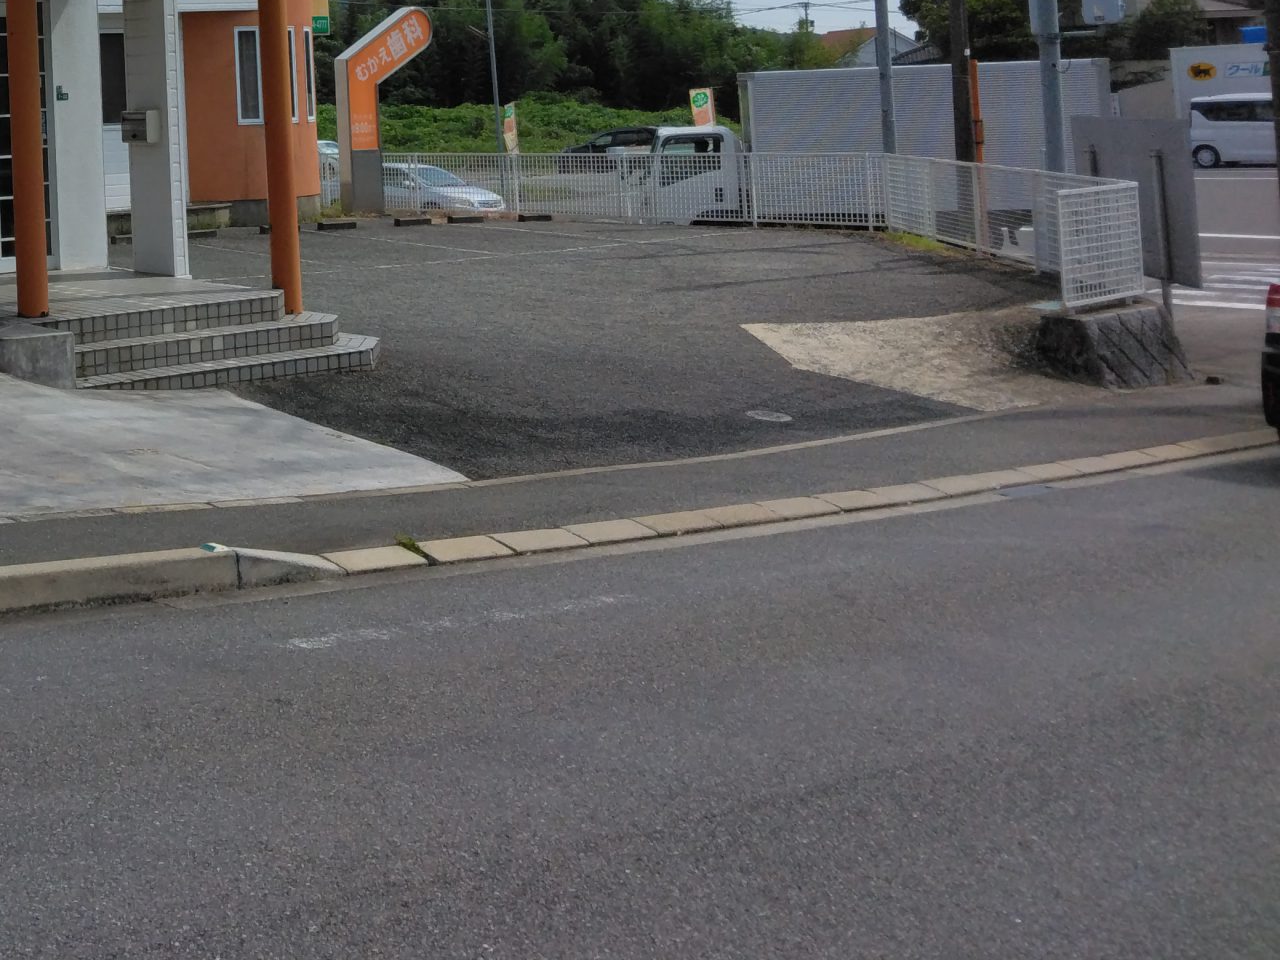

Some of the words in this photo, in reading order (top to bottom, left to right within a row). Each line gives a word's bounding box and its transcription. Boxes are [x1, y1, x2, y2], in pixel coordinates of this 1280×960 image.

[355, 16, 424, 82] むかえ歯科
